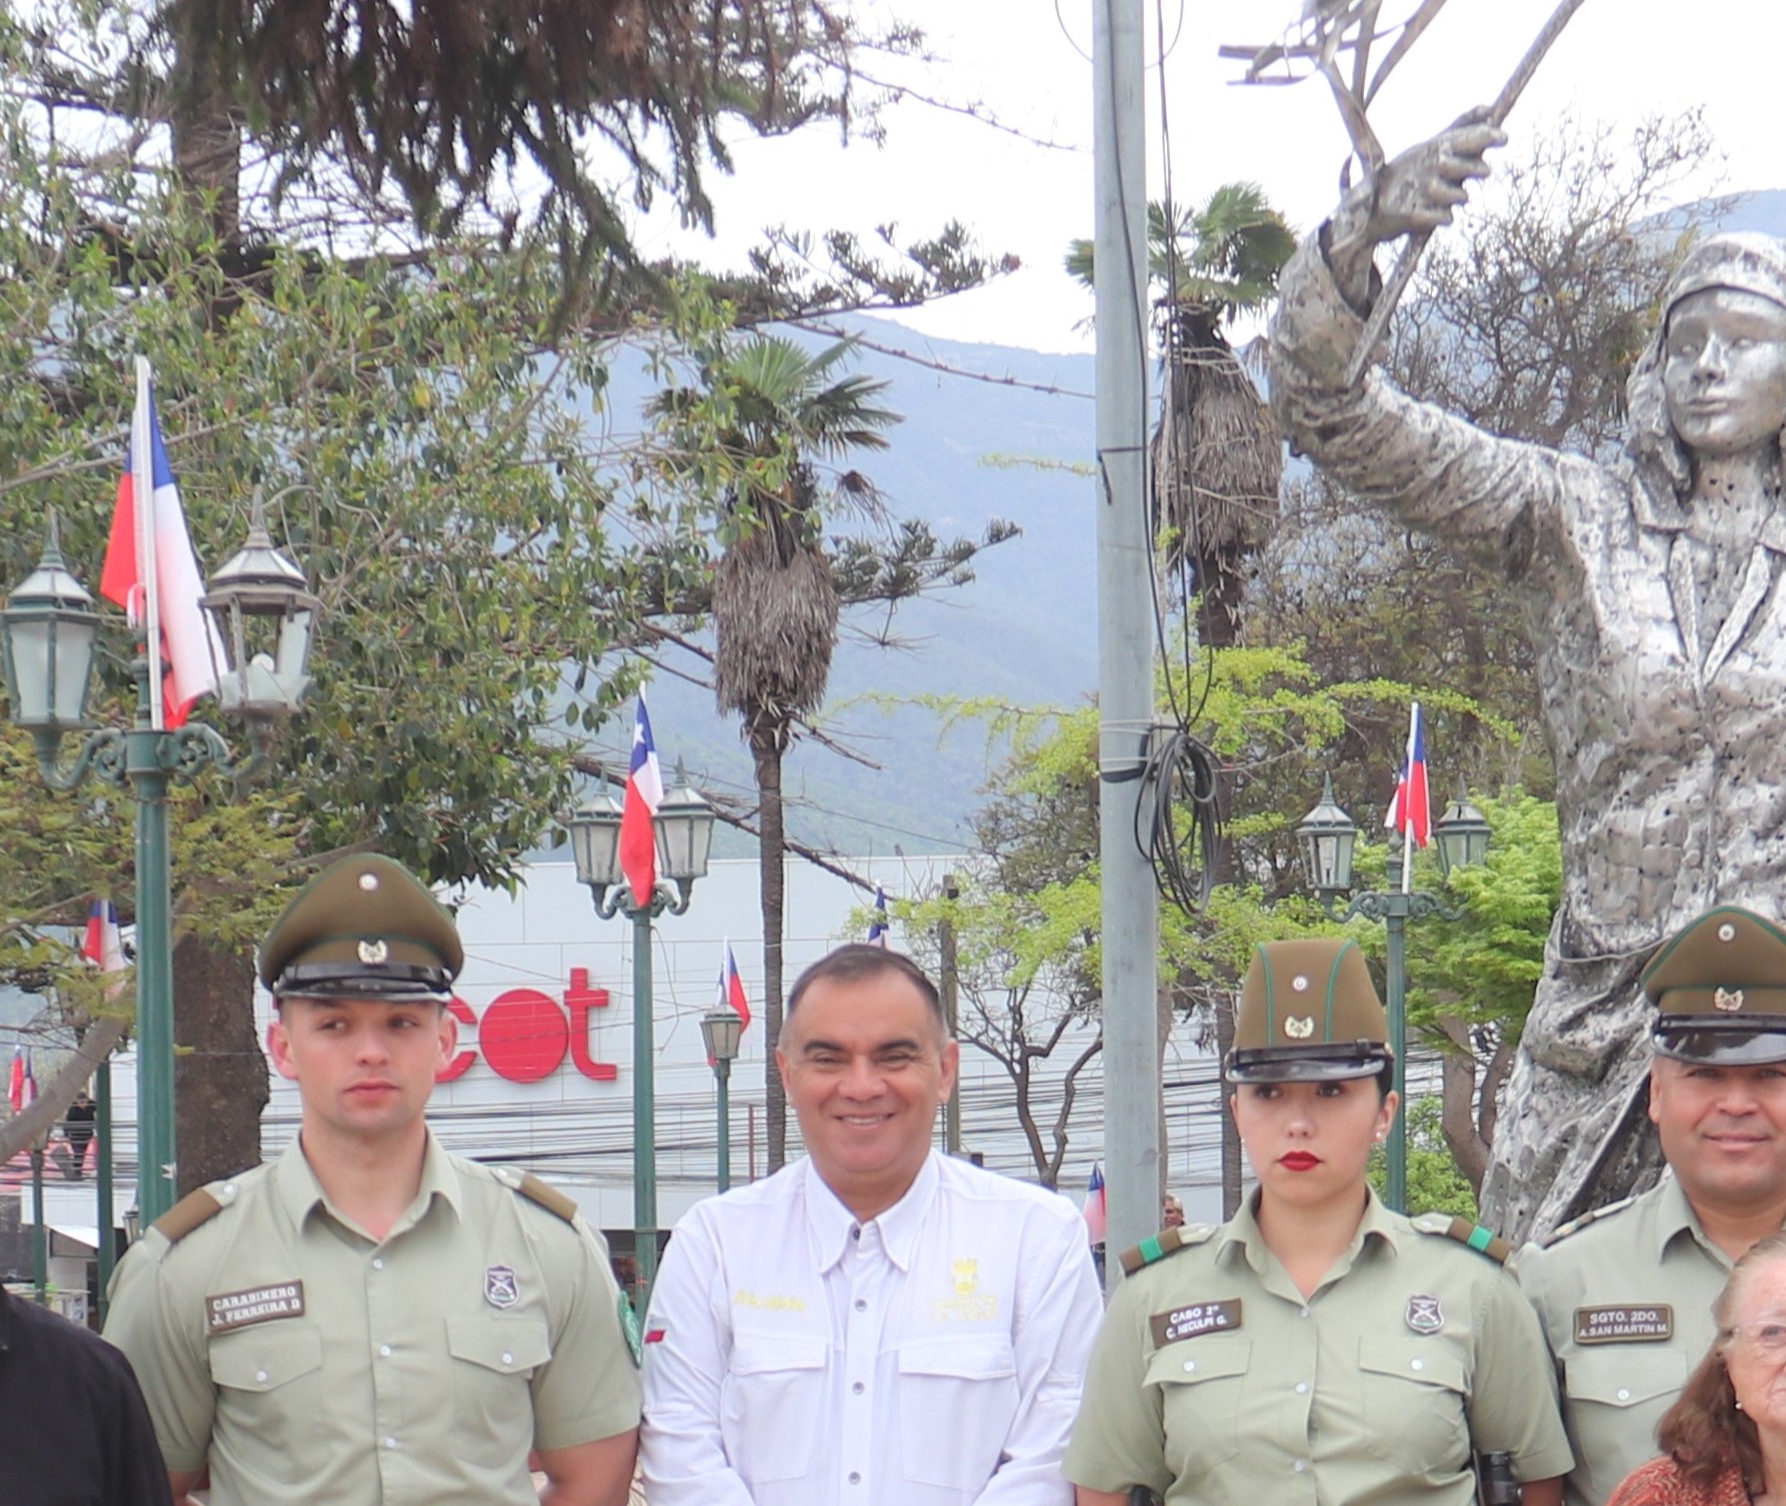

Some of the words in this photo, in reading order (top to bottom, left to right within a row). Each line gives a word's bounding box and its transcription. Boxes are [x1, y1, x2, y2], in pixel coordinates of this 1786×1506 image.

[212, 1286, 296, 1311] CARABINERO
[225, 1301, 289, 1323] FERREIRA
[1170, 1307, 1202, 1324] CABO
[1589, 1310, 1627, 1324] SGTO.
[1630, 1310, 1659, 1323] 2DO.
[1614, 1323, 1655, 1334] MARTIN
